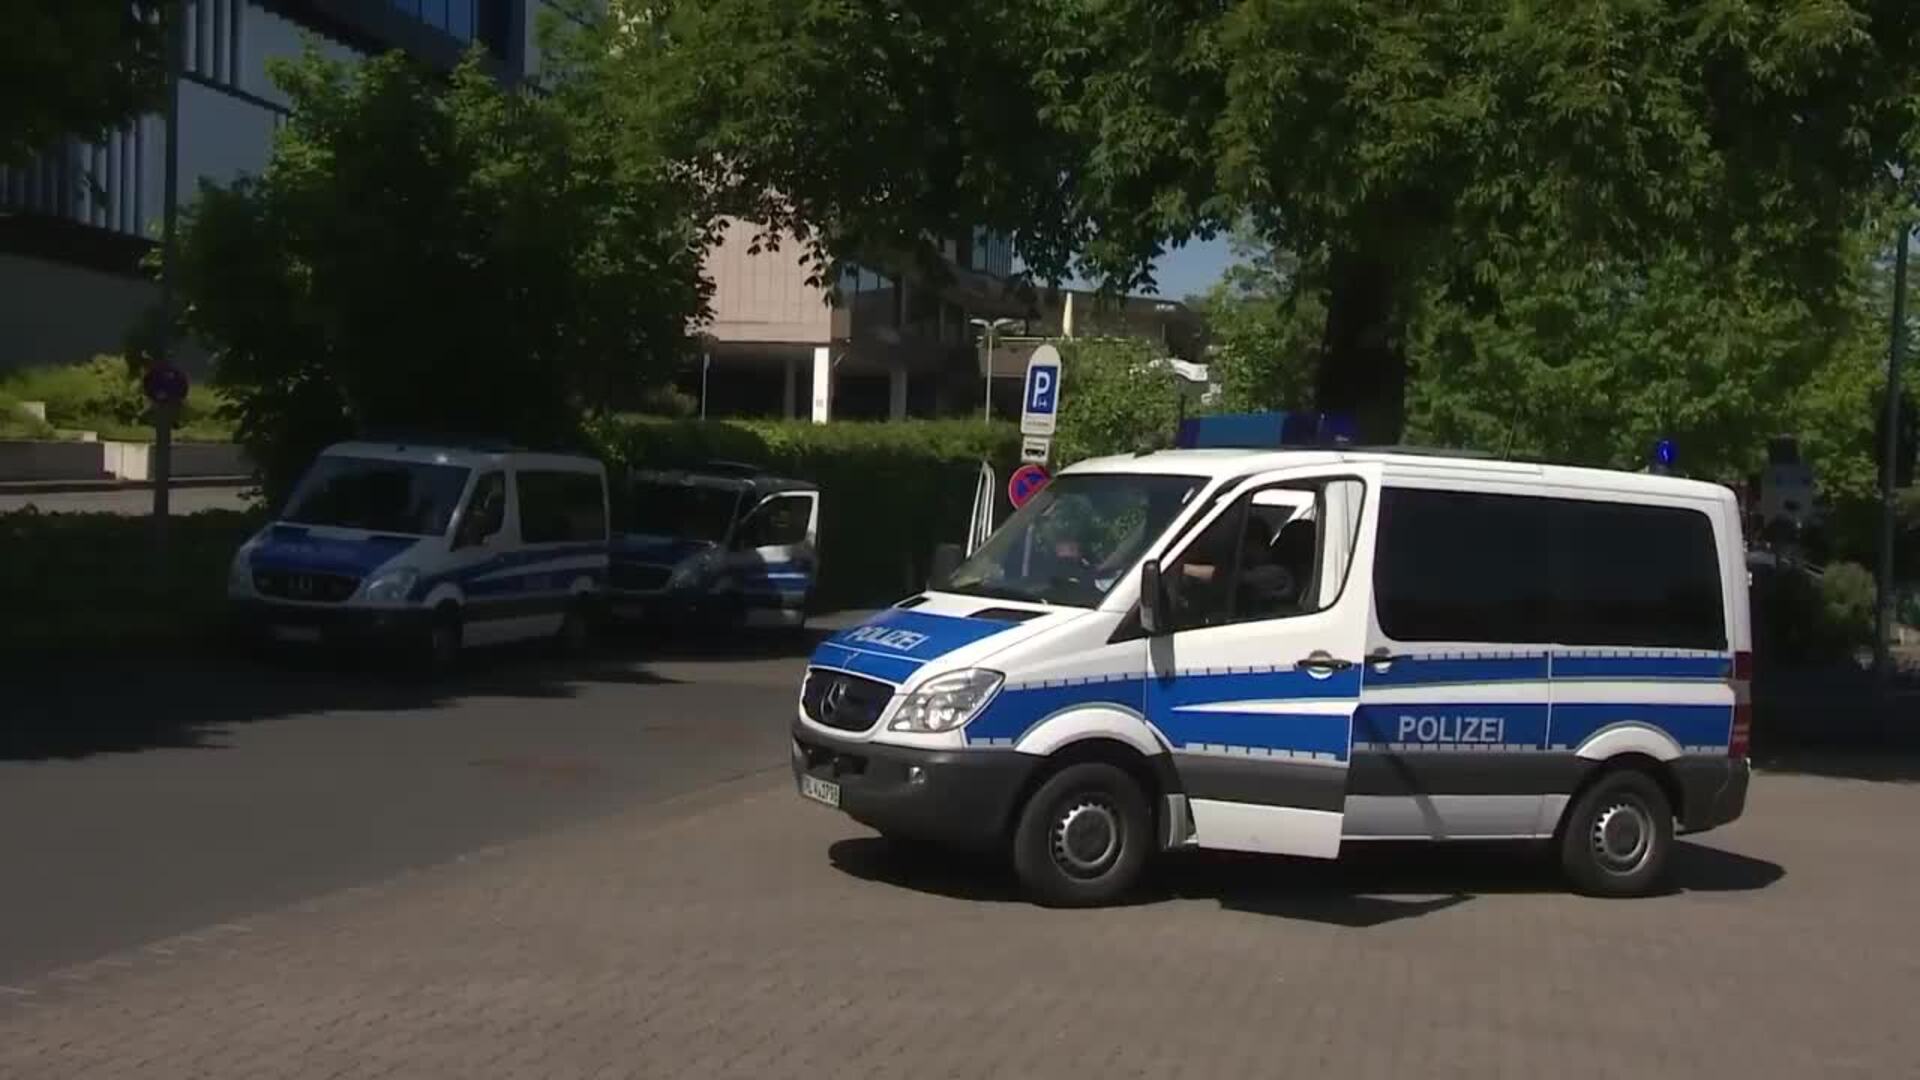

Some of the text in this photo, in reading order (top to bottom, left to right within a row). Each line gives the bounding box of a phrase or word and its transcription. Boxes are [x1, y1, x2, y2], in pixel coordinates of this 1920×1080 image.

[1032, 371, 1051, 409] P
[844, 626, 931, 652] POLIZEI
[1398, 715, 1505, 742] POLIZEI
